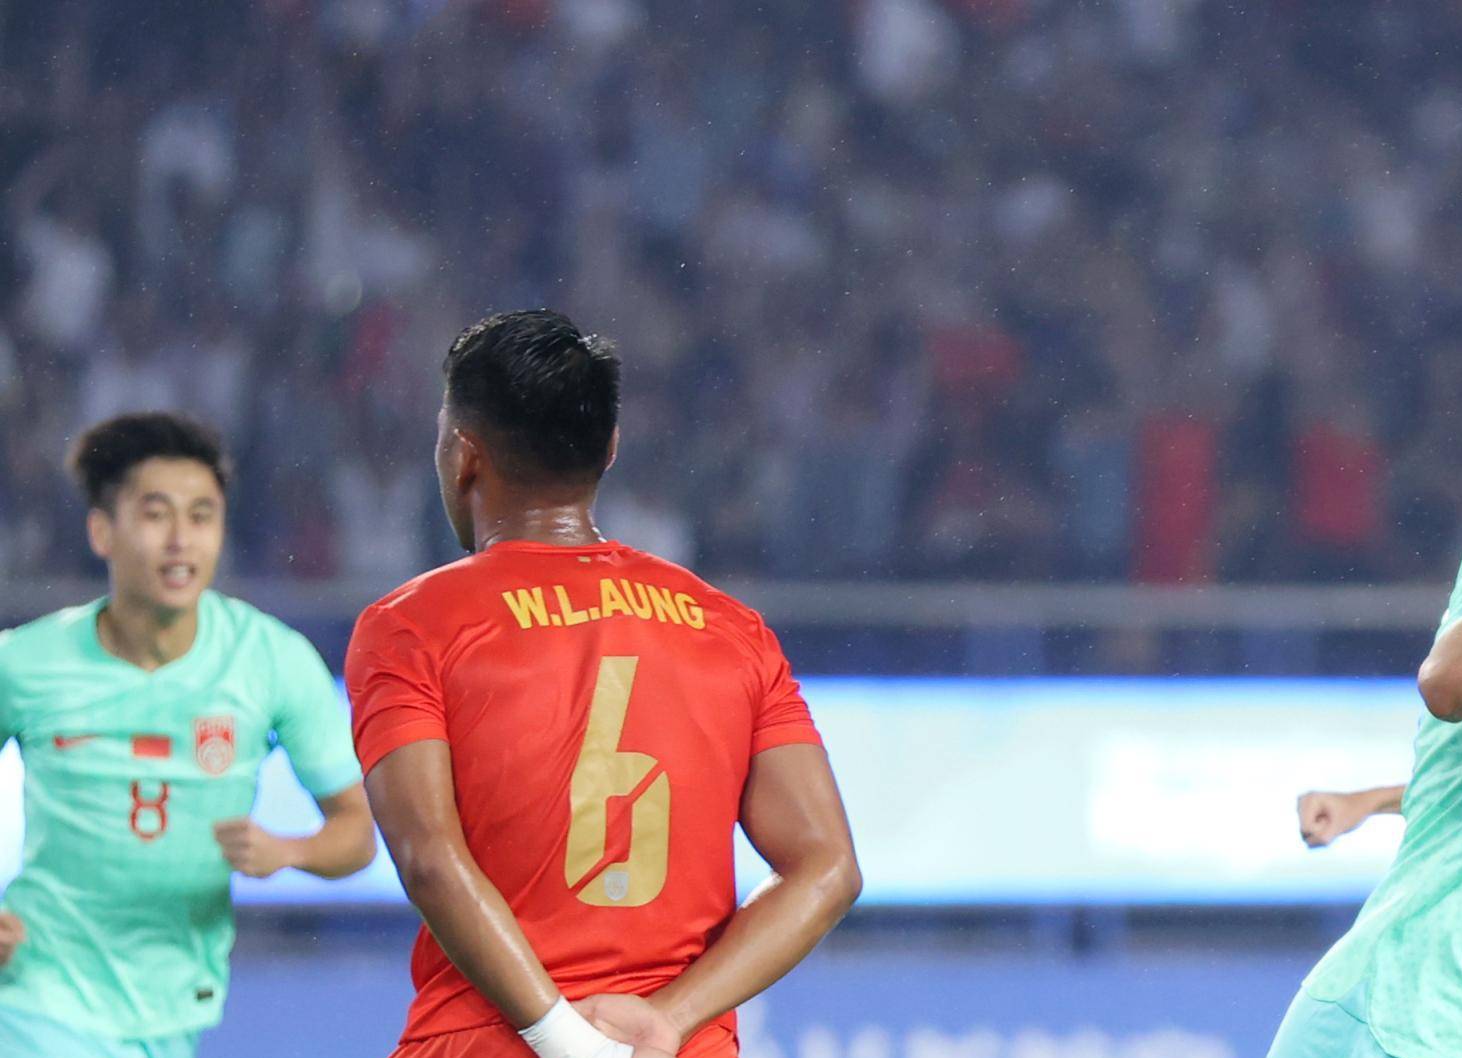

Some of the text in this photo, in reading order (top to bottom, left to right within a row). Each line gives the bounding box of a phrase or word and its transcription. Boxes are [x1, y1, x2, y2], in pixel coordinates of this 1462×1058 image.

[502, 578, 706, 630] W.L.AUNG
[129, 779, 169, 842] 8
[563, 656, 669, 908] 6
